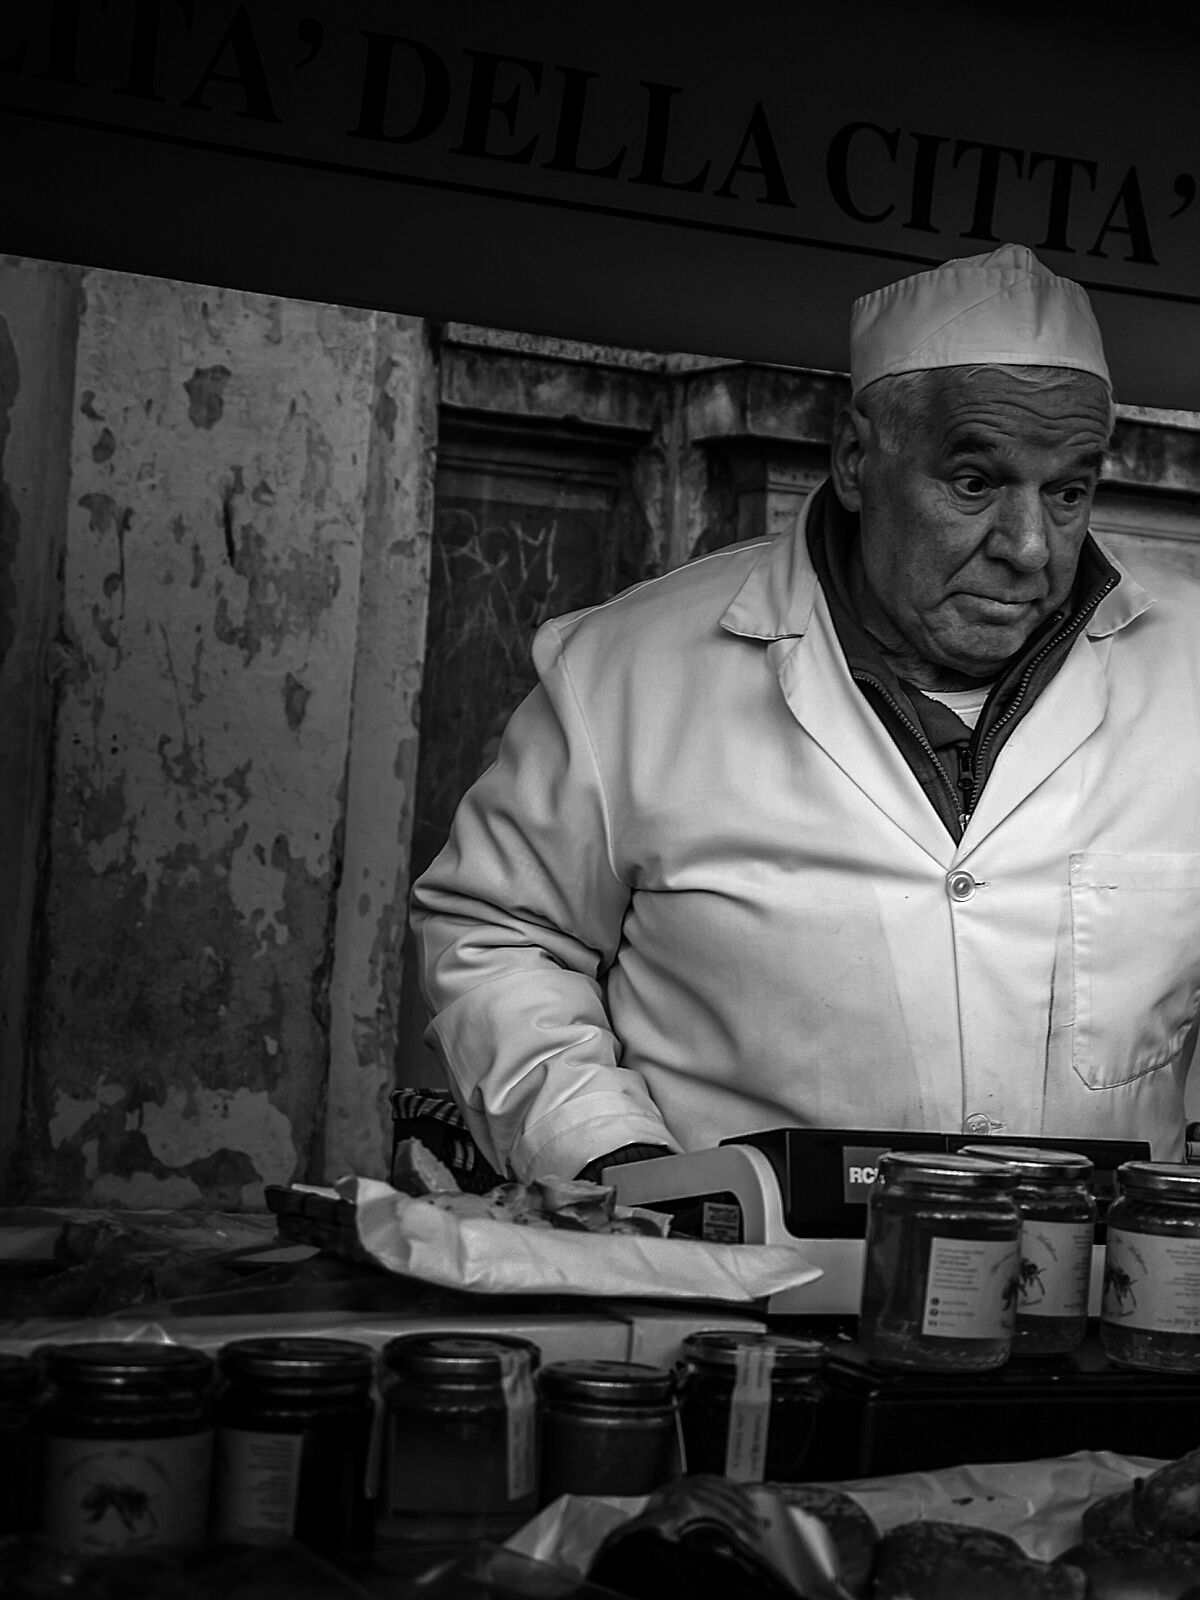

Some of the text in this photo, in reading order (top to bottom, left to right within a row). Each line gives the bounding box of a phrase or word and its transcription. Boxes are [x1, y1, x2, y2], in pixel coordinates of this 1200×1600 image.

[347, 29, 797, 208] DELLA
[827, 121, 1196, 266] CITTA'
[848, 1166, 882, 1184] RC
